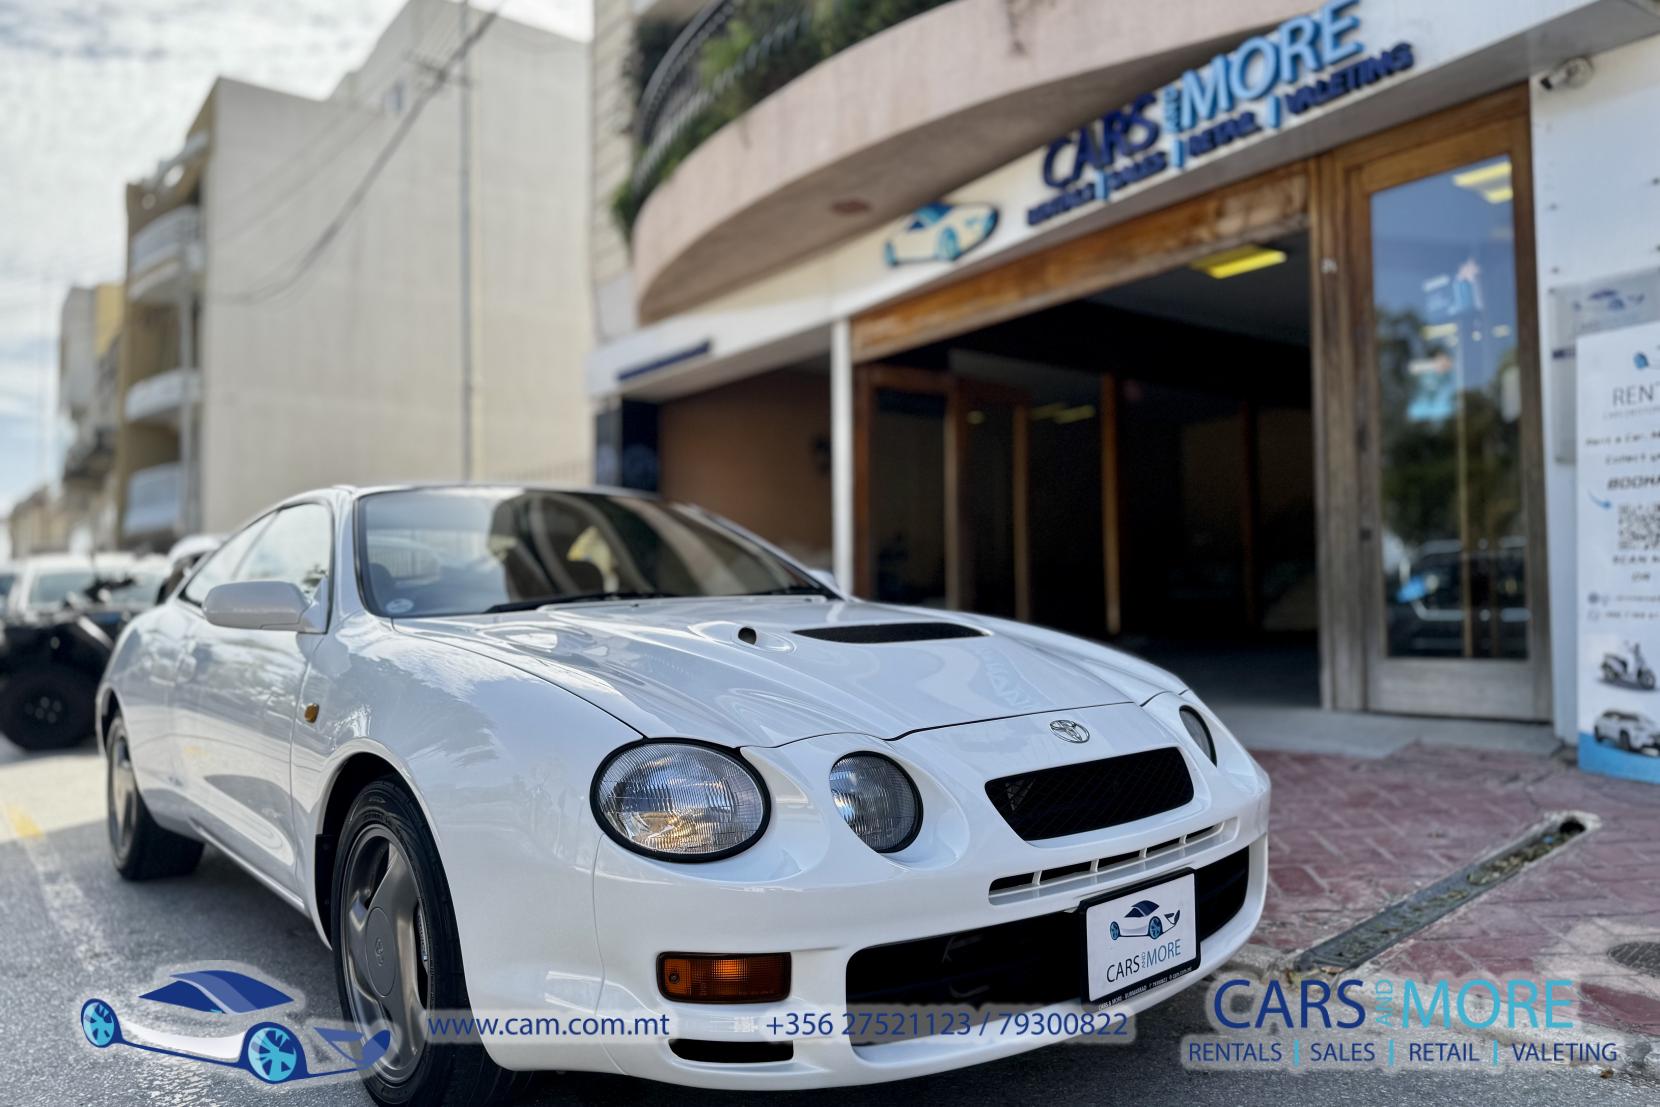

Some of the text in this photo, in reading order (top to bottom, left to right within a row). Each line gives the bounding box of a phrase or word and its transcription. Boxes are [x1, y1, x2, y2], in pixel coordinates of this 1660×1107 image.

[1043, 92, 1160, 189] CARS
[1180, 0, 1363, 130] MORE
[1106, 955, 1140, 983] CARS
[1146, 938, 1181, 968] MORE
